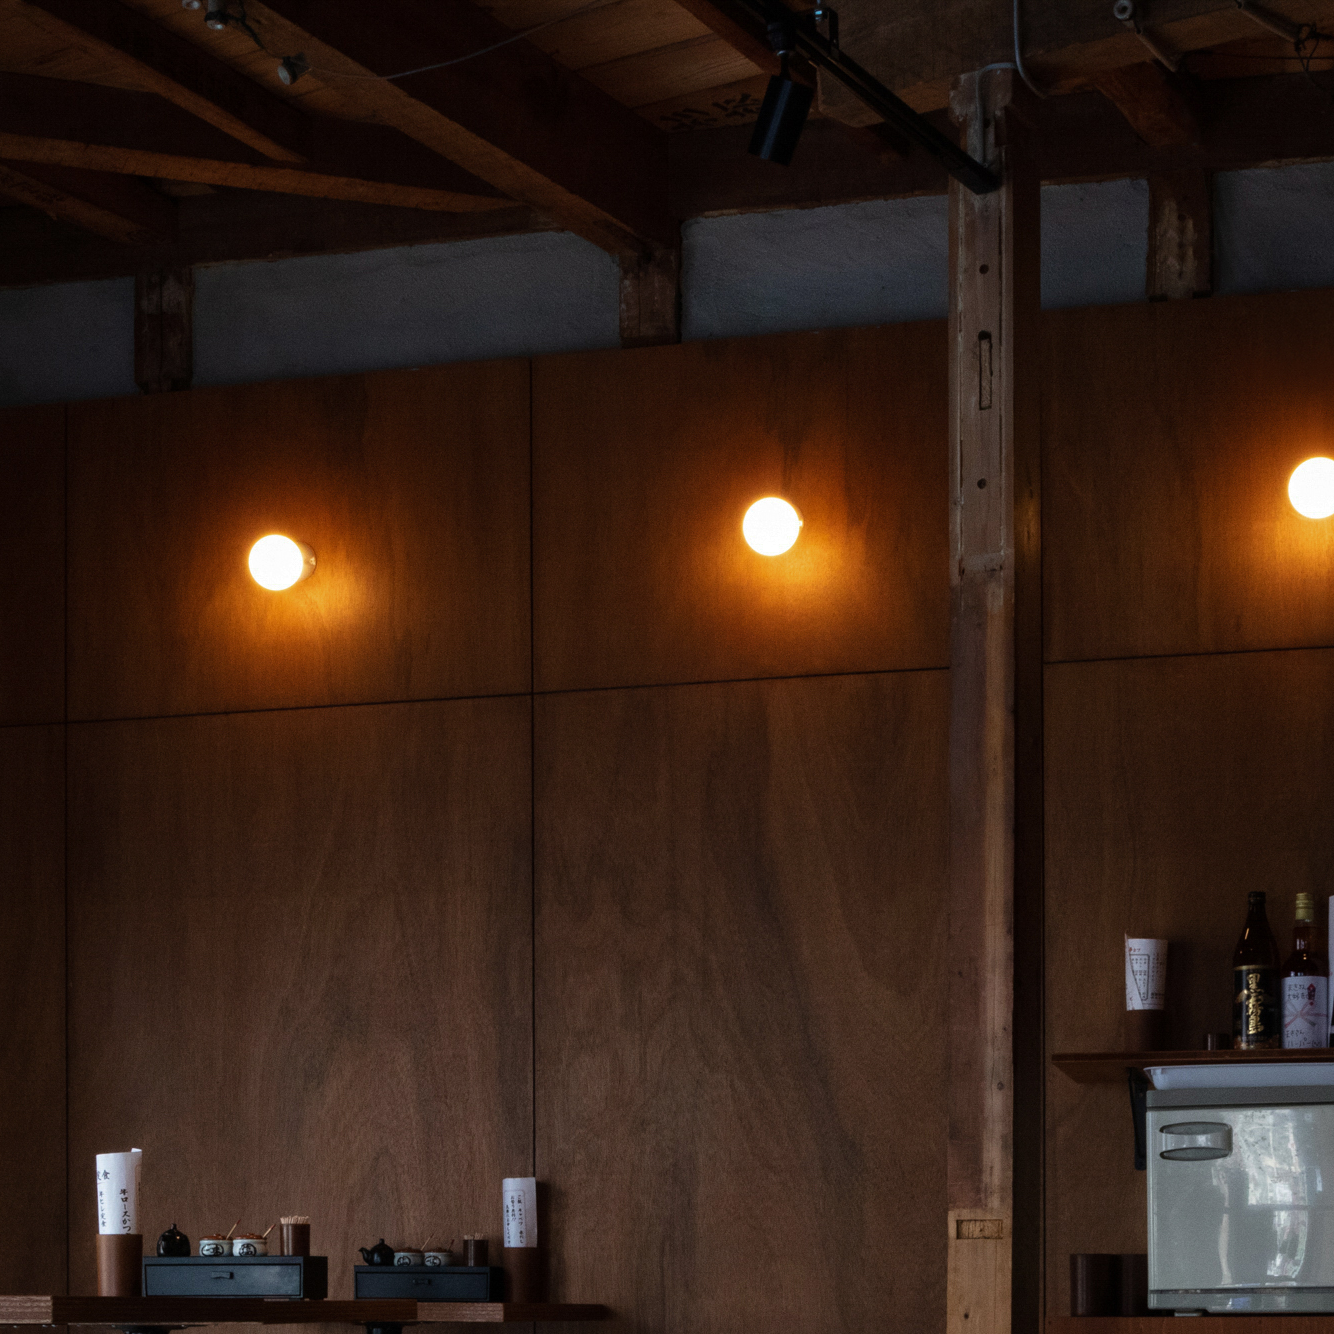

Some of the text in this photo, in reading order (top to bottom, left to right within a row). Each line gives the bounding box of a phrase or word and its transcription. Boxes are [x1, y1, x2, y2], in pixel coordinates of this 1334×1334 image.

[119, 1188, 132, 1235] 牛ロースかつ
